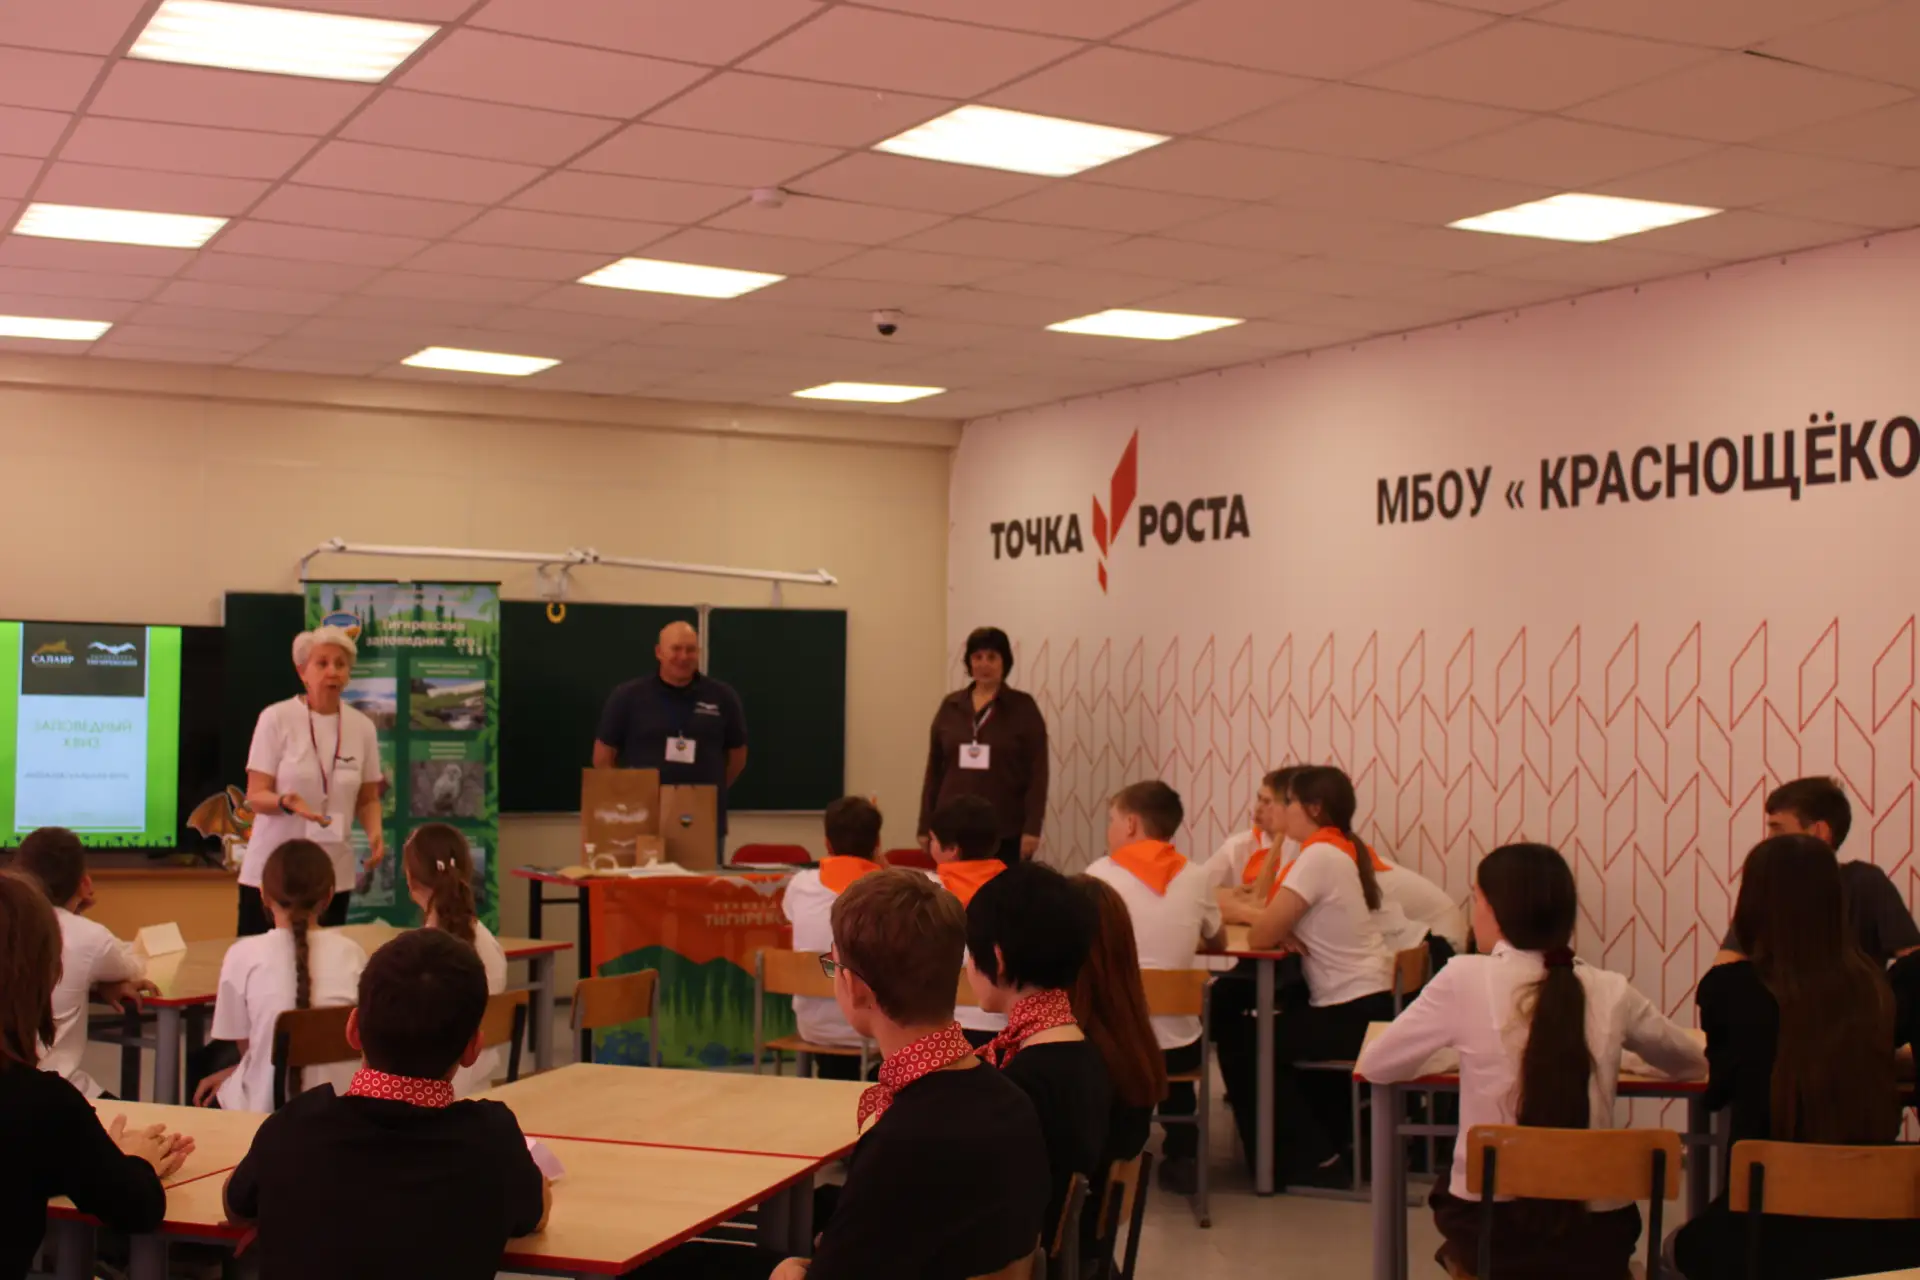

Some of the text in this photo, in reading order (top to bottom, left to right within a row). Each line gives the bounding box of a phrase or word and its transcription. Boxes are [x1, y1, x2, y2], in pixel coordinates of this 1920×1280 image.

[1376, 465, 1492, 526] МБОУ
[1539, 410, 1920, 511] КРАСНОЩЁКО
[990, 494, 1251, 560] ТОЧКА РОСТА
[31, 655, 74, 664] САЛАИР
[365, 636, 447, 648] заповедник
